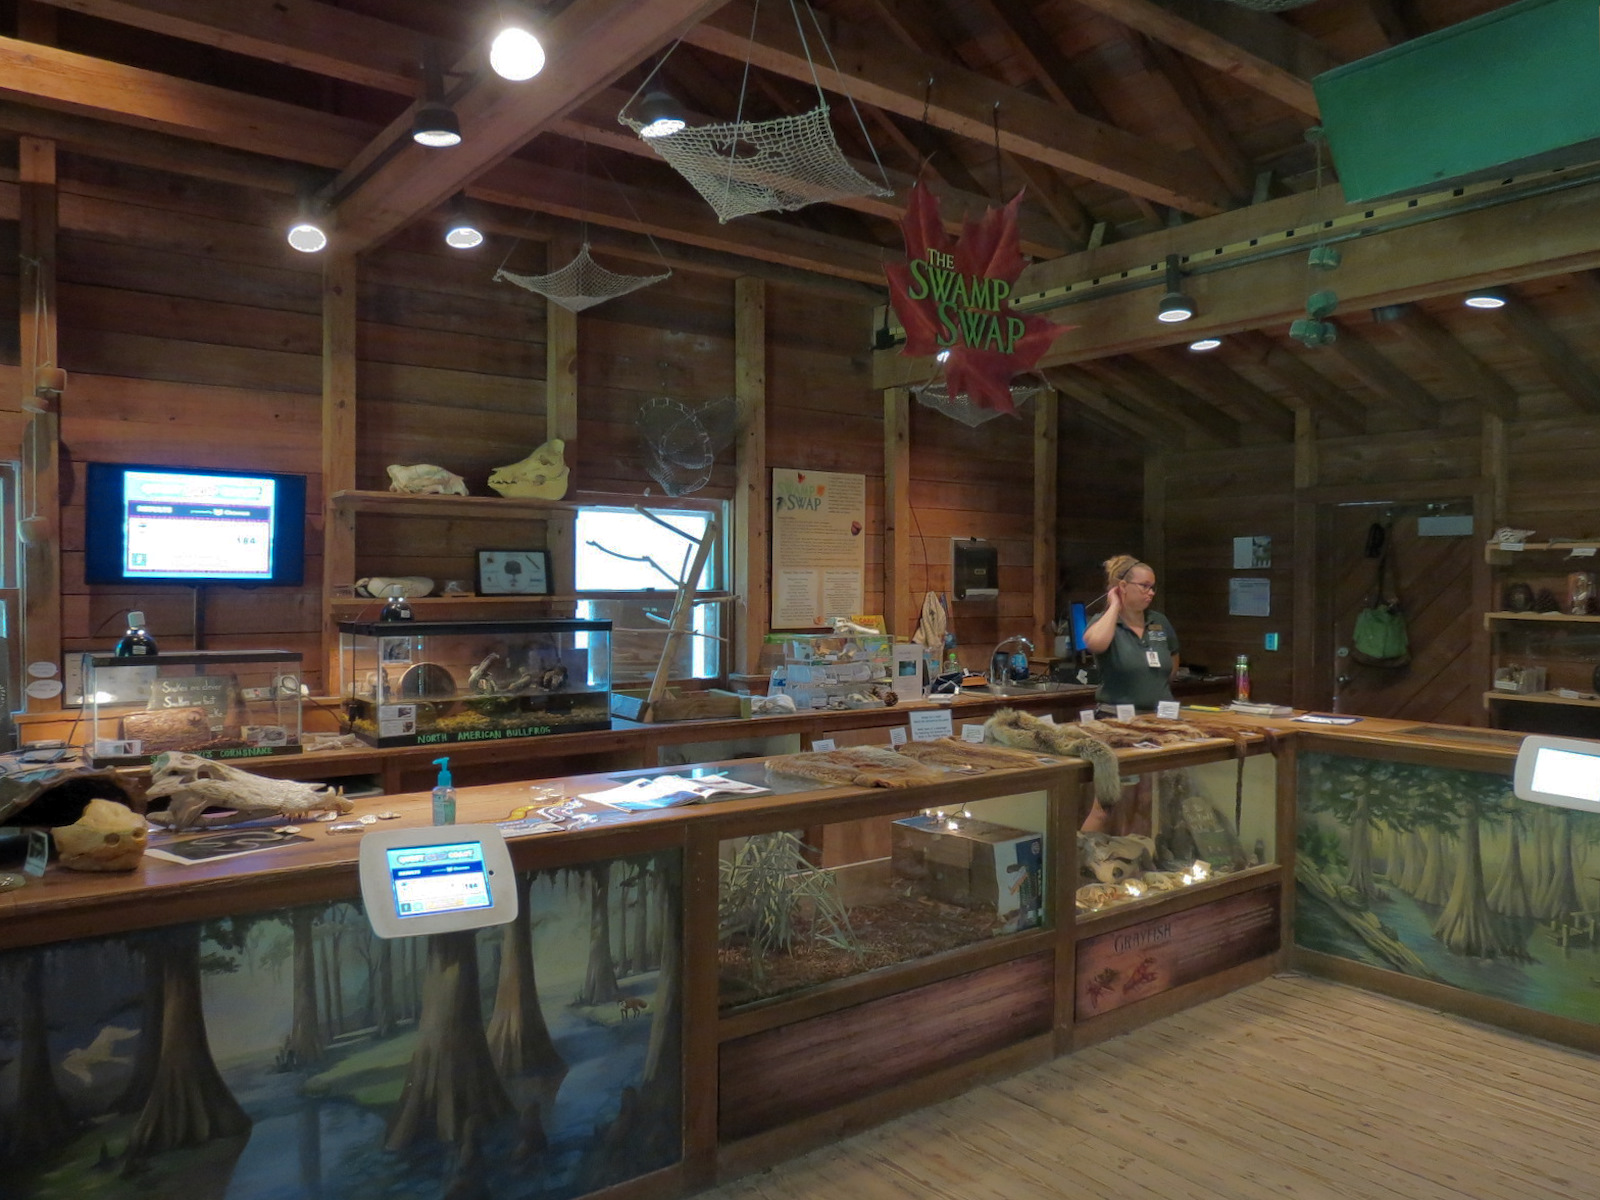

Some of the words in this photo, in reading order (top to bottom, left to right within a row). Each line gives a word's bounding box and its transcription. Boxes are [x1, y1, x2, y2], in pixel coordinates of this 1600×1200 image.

[927, 248, 954, 269] THE
[908, 259, 1010, 312] SWAMP
[937, 302, 1025, 354] SWAP
[787, 494, 822, 511] SWAP
[417, 733, 447, 744] NORTH
[457, 729, 501, 741] AMERICAN
[506, 726, 551, 738] BULLFROG
